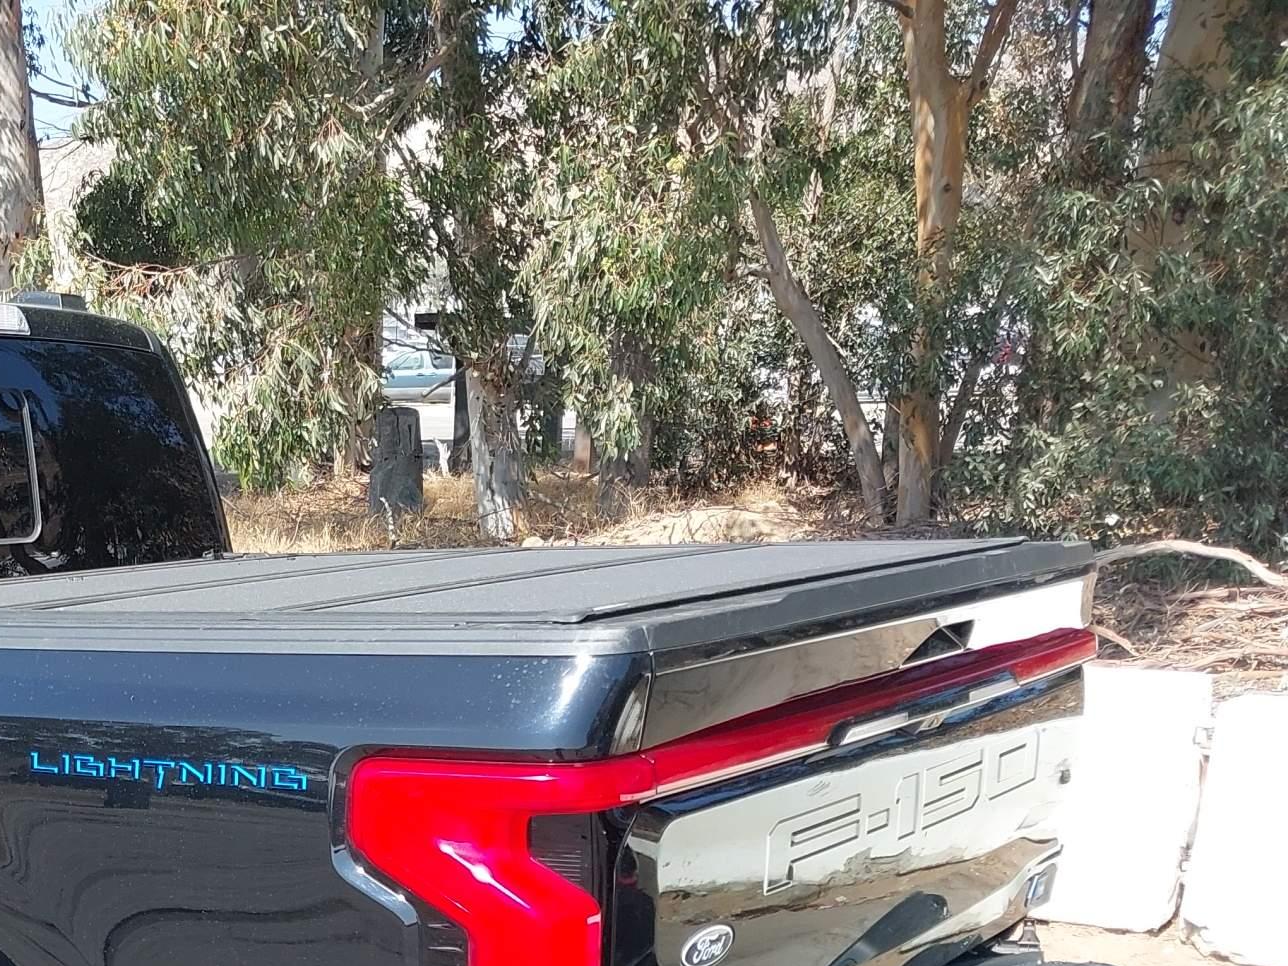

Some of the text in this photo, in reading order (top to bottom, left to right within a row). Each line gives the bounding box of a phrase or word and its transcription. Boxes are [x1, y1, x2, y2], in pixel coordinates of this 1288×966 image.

[30, 751, 308, 791] LIGHTNING
[763, 730, 1040, 896] F-150
[693, 931, 728, 964] Ford
